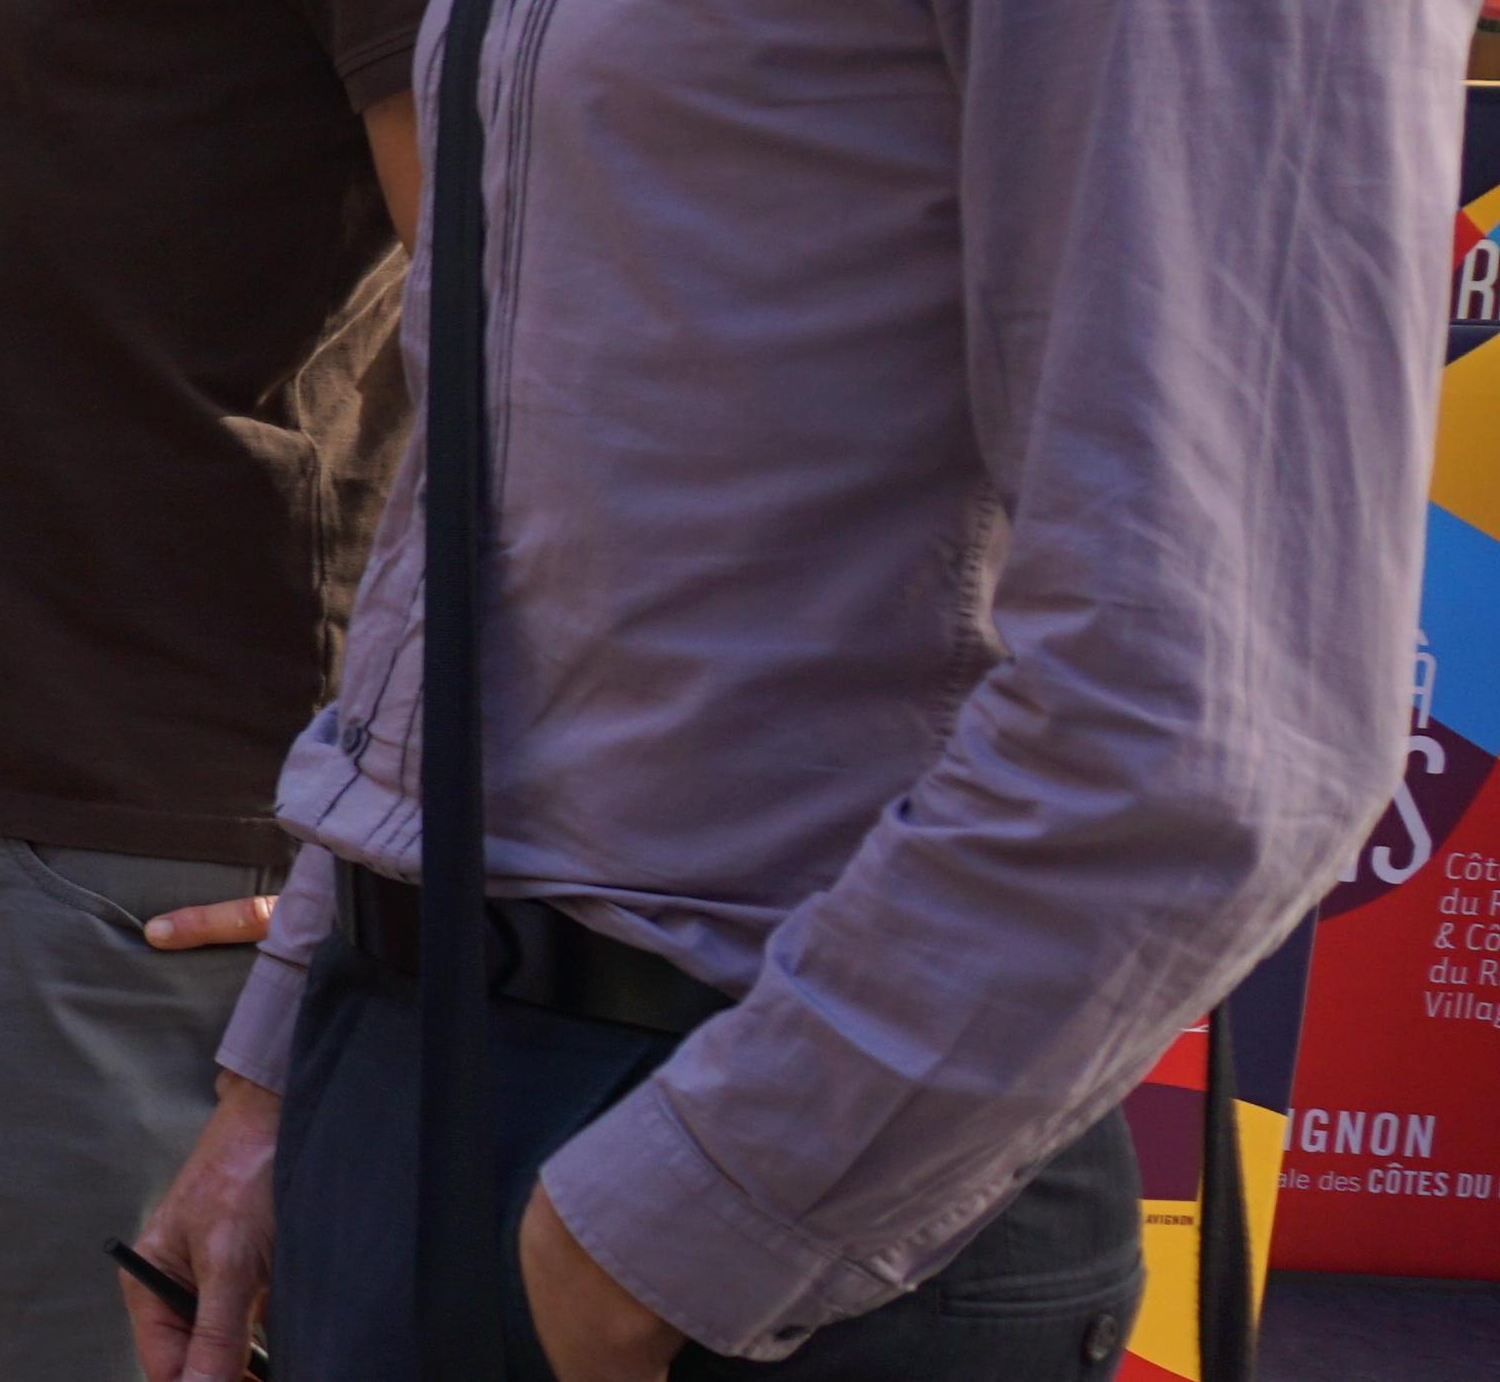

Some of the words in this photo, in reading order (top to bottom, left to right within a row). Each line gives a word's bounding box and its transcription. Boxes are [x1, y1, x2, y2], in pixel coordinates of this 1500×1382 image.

[1445, 852, 1500, 881] Côt
[1439, 887, 1479, 915] du
[1434, 922, 1455, 949] &
[1466, 924, 1500, 951] Cô
[1429, 956, 1467, 985] du
[1283, 1107, 1436, 1159] IGNON
[1278, 1169, 1310, 1189] ale
[1318, 1171, 1361, 1192] des
[1367, 1162, 1450, 1197] CÔTES
[1456, 1172, 1493, 1199] DU
